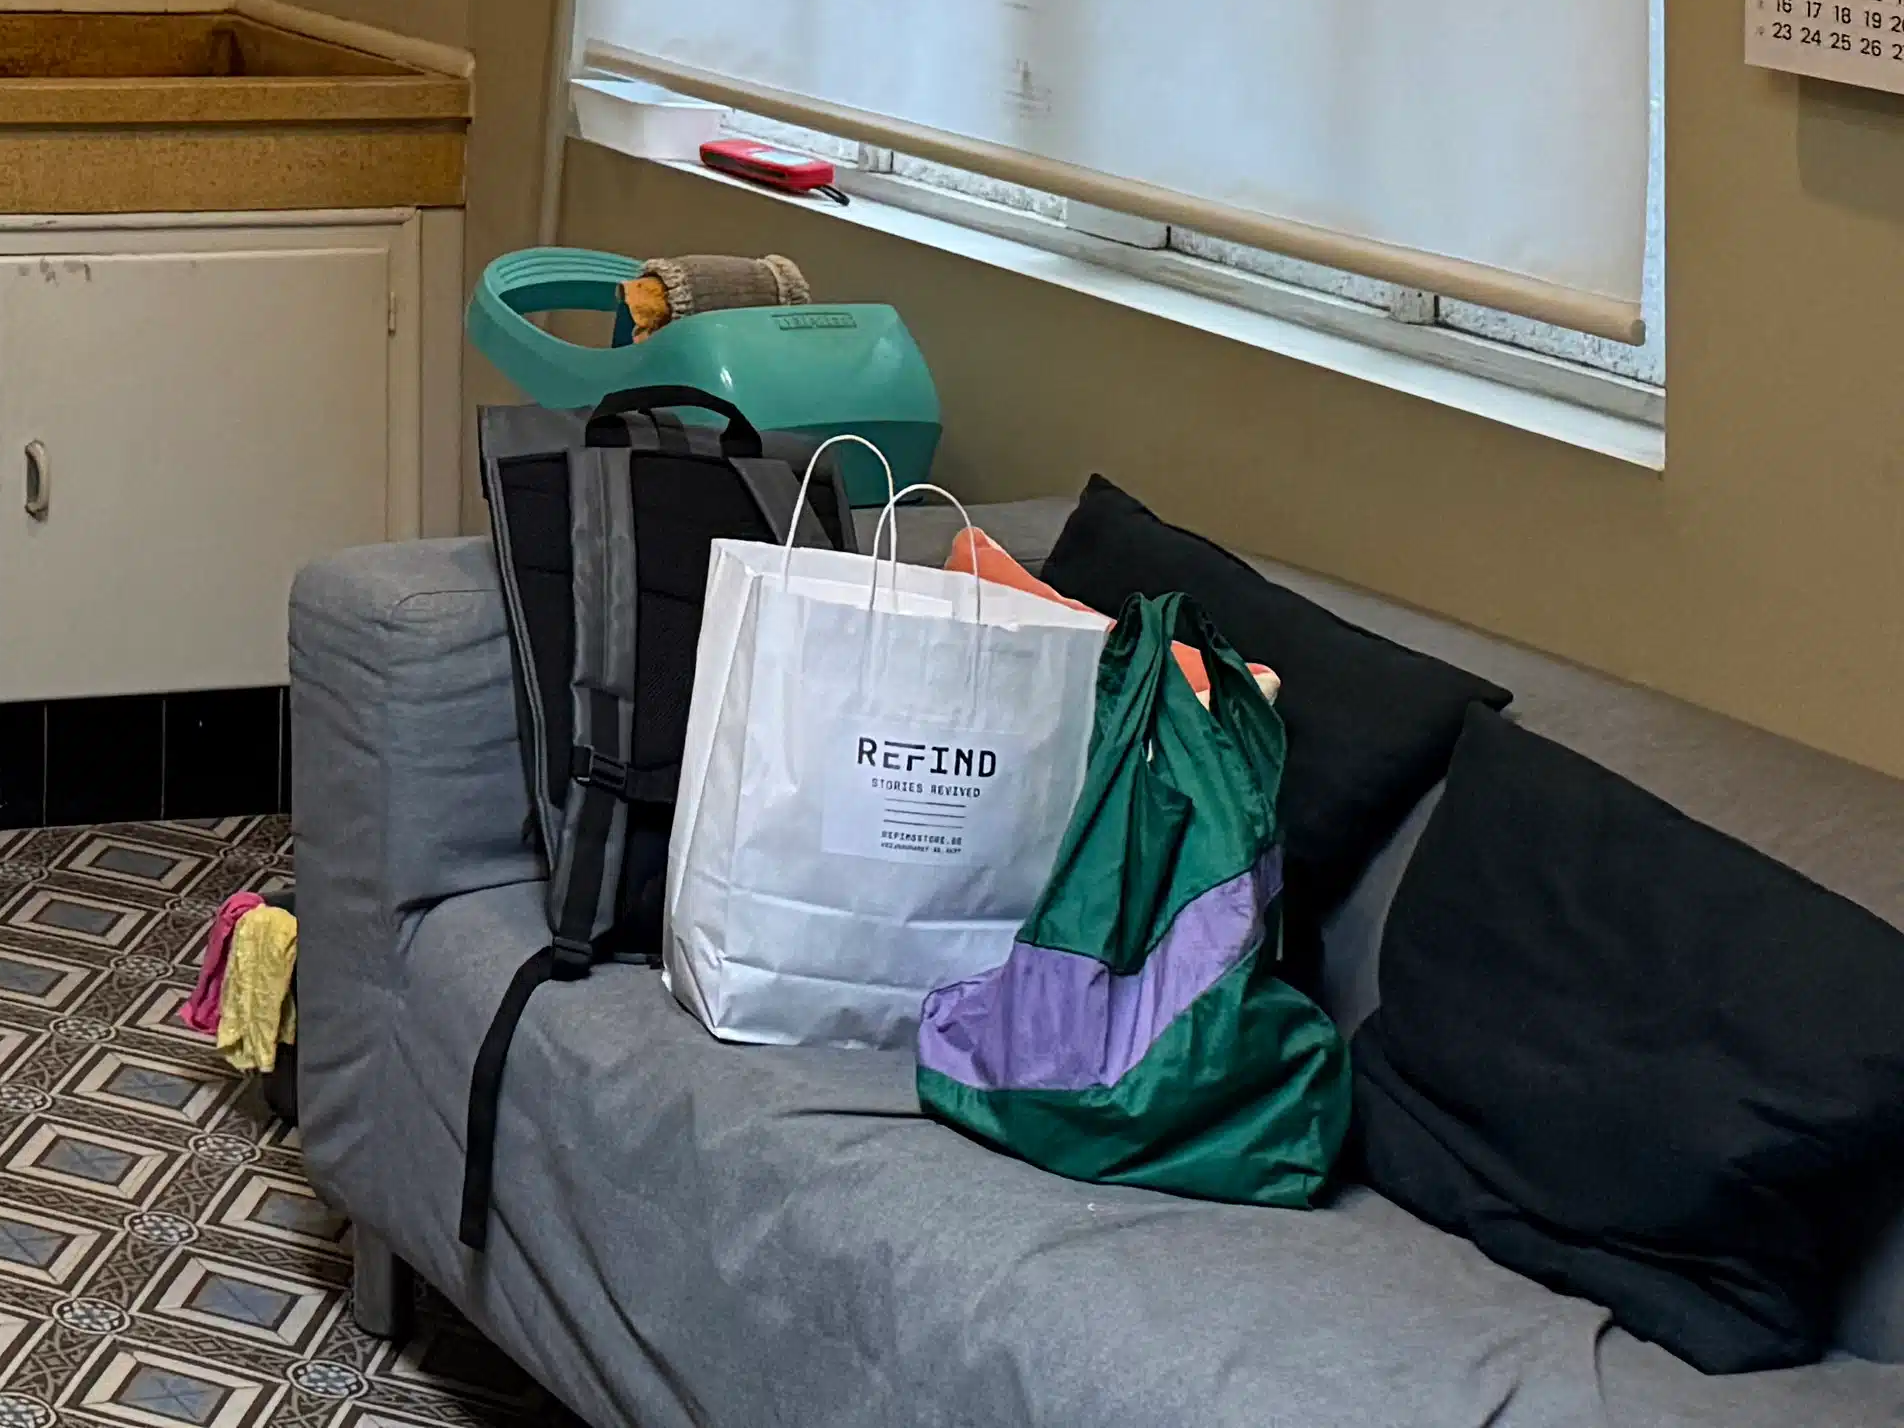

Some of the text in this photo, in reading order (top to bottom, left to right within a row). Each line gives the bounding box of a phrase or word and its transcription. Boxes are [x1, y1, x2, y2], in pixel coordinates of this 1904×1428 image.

[1807, 0, 1822, 18] 17
[1835, 5, 1851, 24] 18
[1865, 11, 1882, 29] 19
[1890, 16, 1904, 33] 2
[1772, 22, 1904, 61] 23 24 25 26 2
[857, 737, 996, 778] REFIND
[871, 778, 981, 798] STORIES REVIVED
